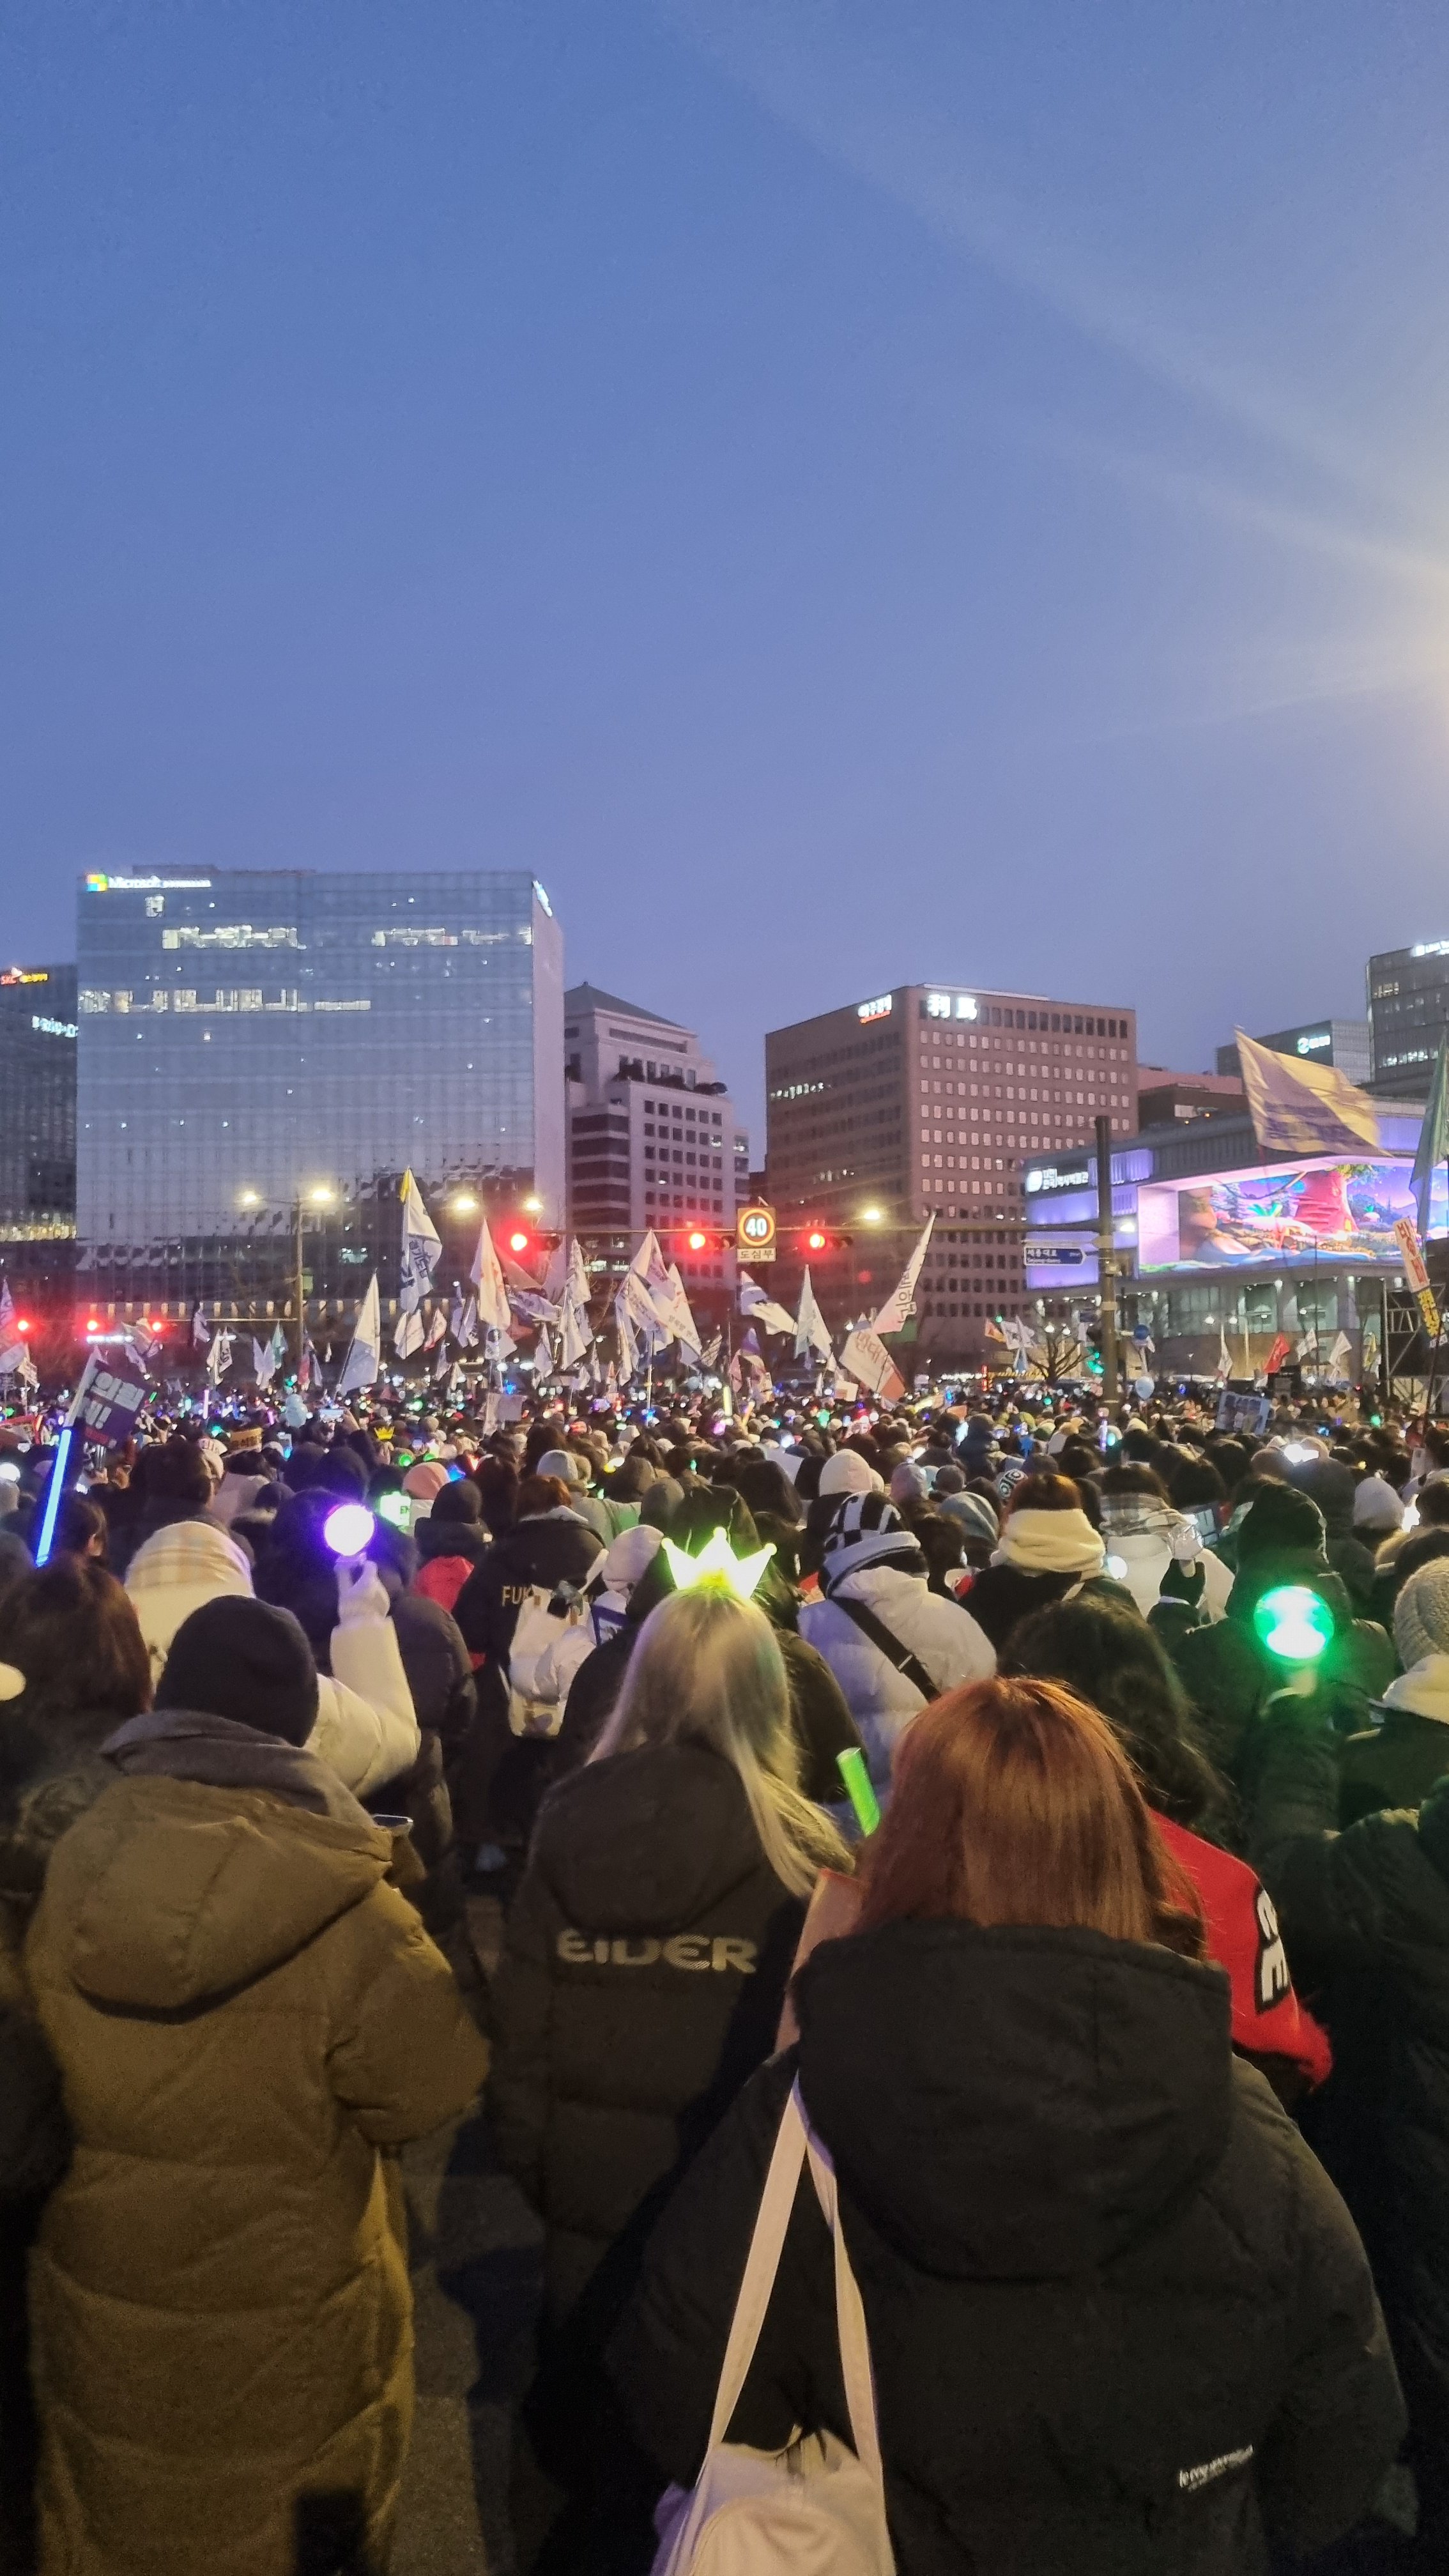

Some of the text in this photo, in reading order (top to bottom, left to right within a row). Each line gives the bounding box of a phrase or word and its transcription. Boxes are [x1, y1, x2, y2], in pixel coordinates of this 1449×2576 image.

[746, 1218, 767, 1237] 40
[740, 1250, 774, 1259] 도심부
[555, 1929, 758, 1974] EIDER
